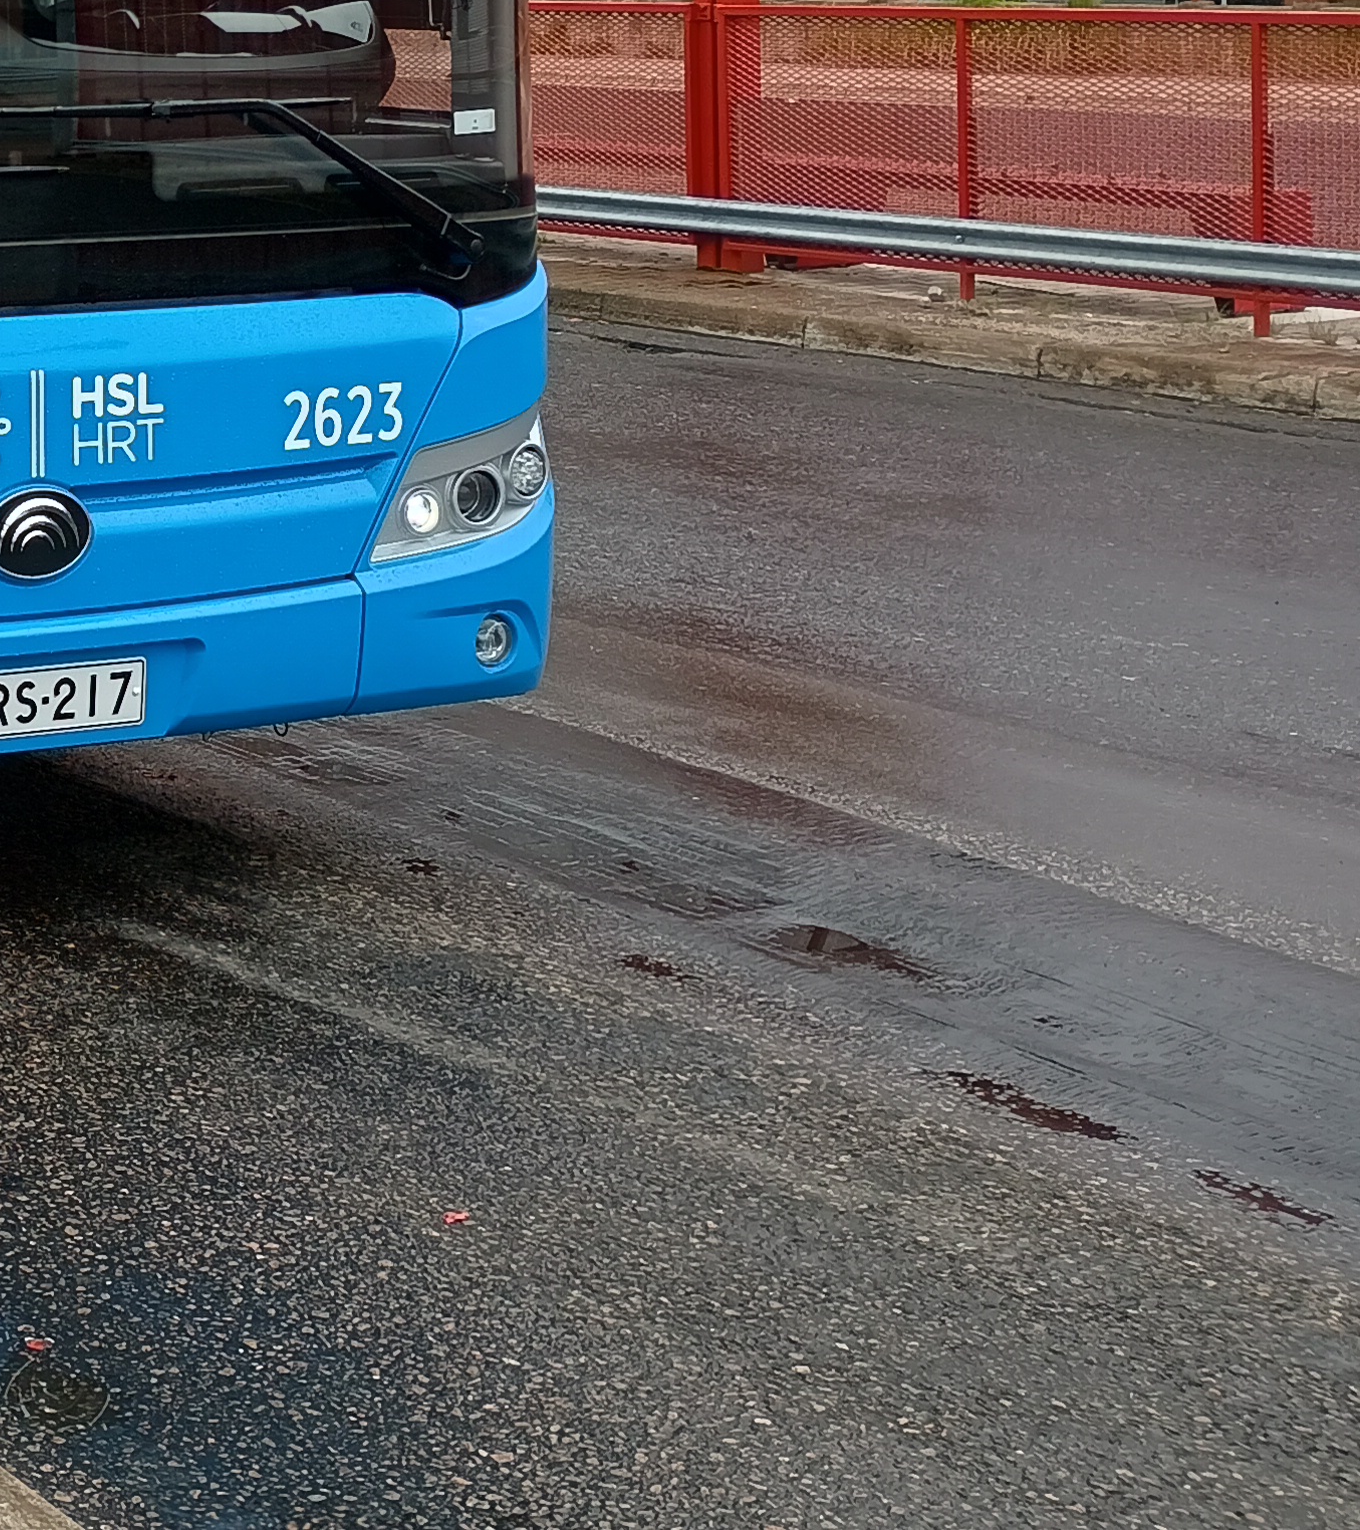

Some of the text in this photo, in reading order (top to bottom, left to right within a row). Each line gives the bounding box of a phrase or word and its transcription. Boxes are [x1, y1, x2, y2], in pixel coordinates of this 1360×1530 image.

[72, 372, 164, 418] HSL
[283, 381, 403, 451] 2623
[72, 417, 165, 467] HRT
